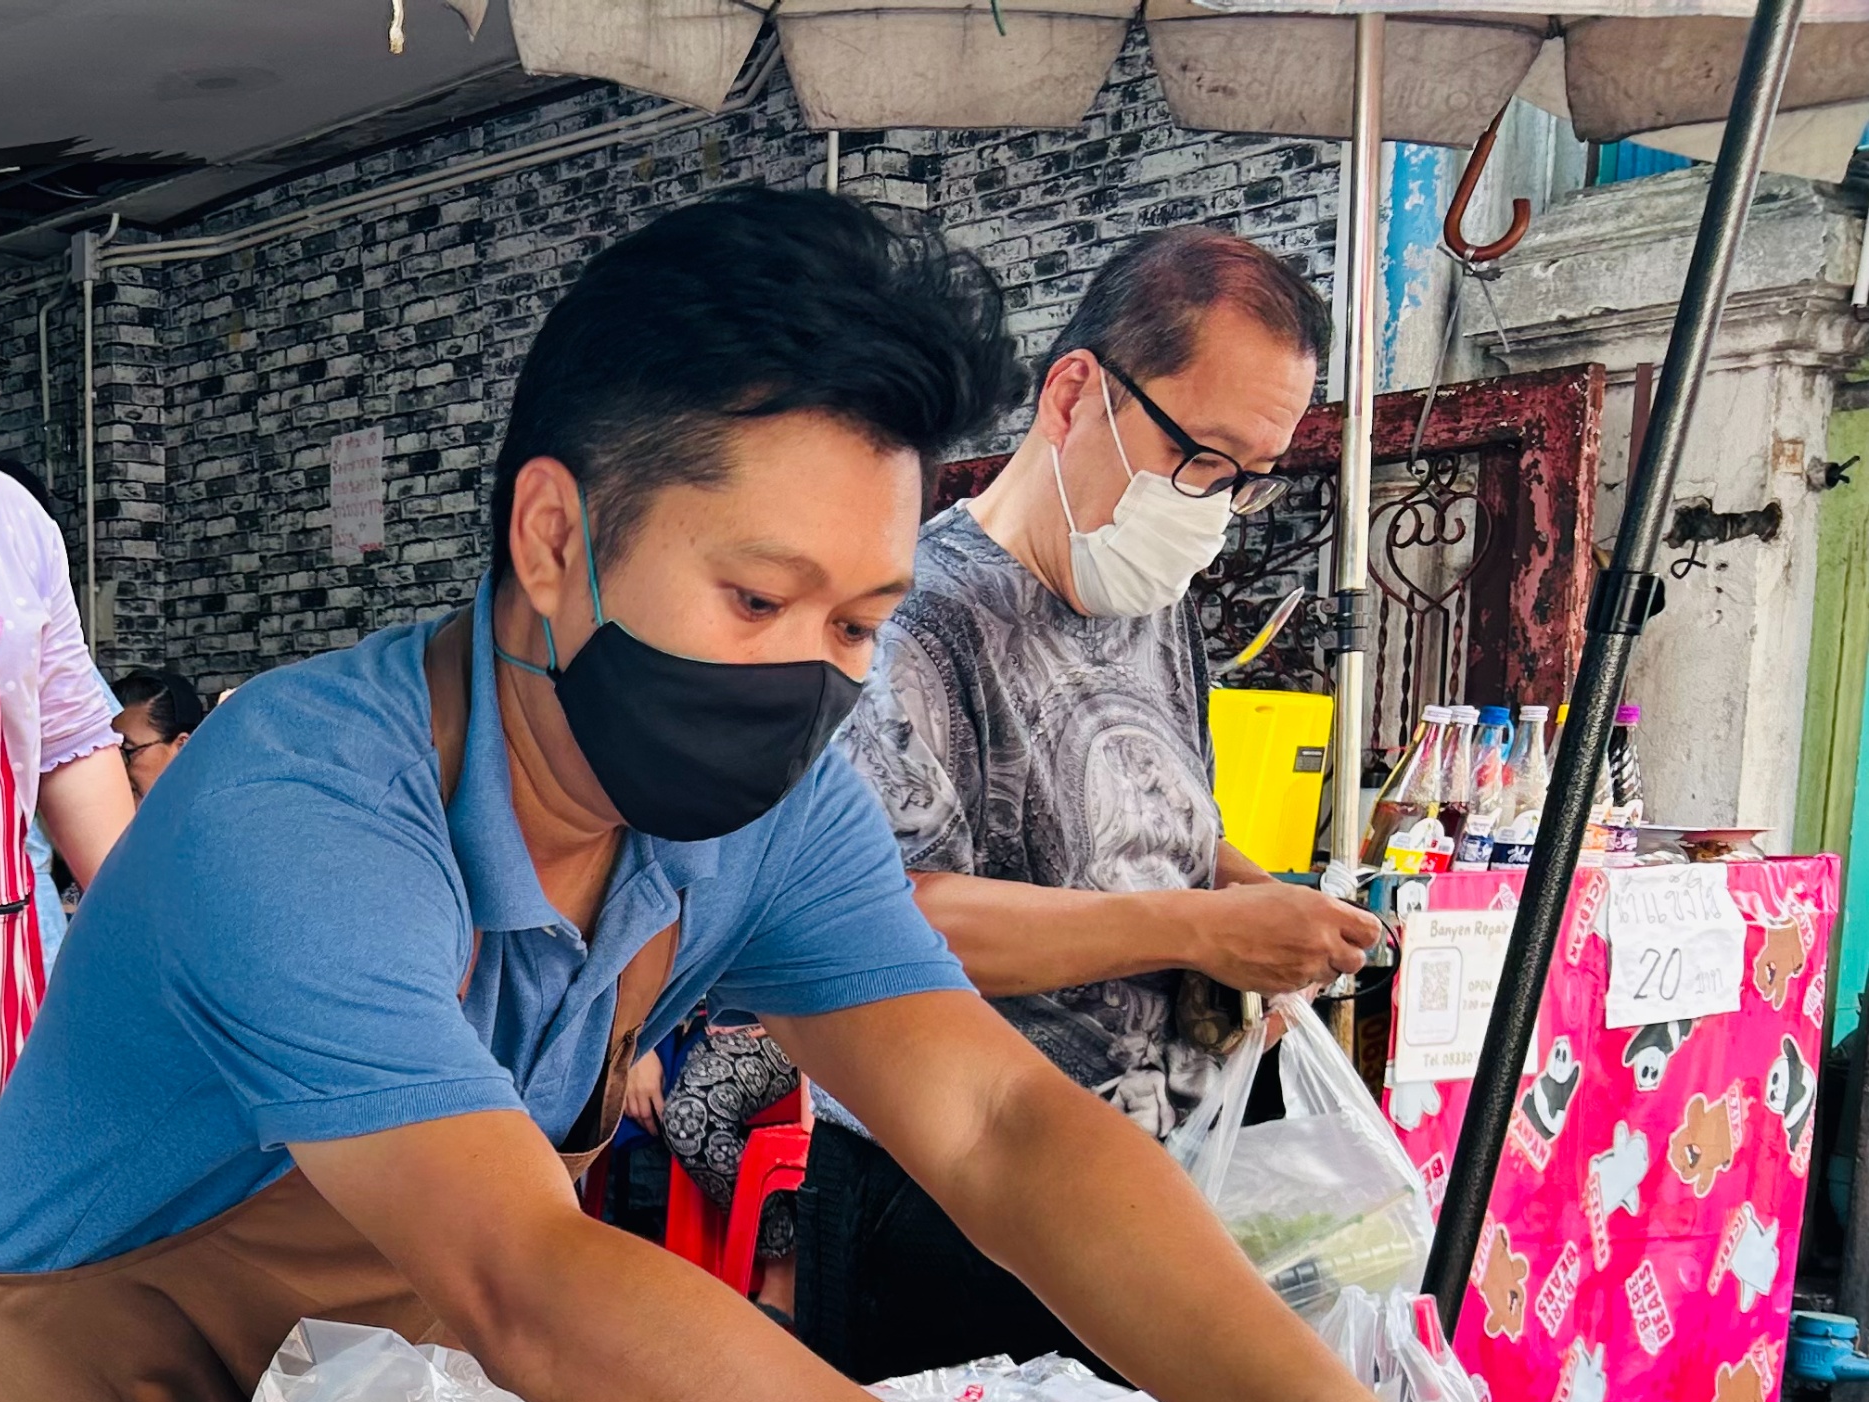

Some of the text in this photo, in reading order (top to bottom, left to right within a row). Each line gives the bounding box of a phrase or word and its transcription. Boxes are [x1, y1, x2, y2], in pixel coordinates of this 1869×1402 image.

[1430, 919, 1509, 942] Banyen Repair
[1468, 980, 1492, 992] OPEN
[1633, 947, 1683, 1001] 20
[1537, 1245, 1577, 1316] BEARS
[1628, 1276, 1652, 1332] BARE
[1638, 1264, 1671, 1341] BEARS
